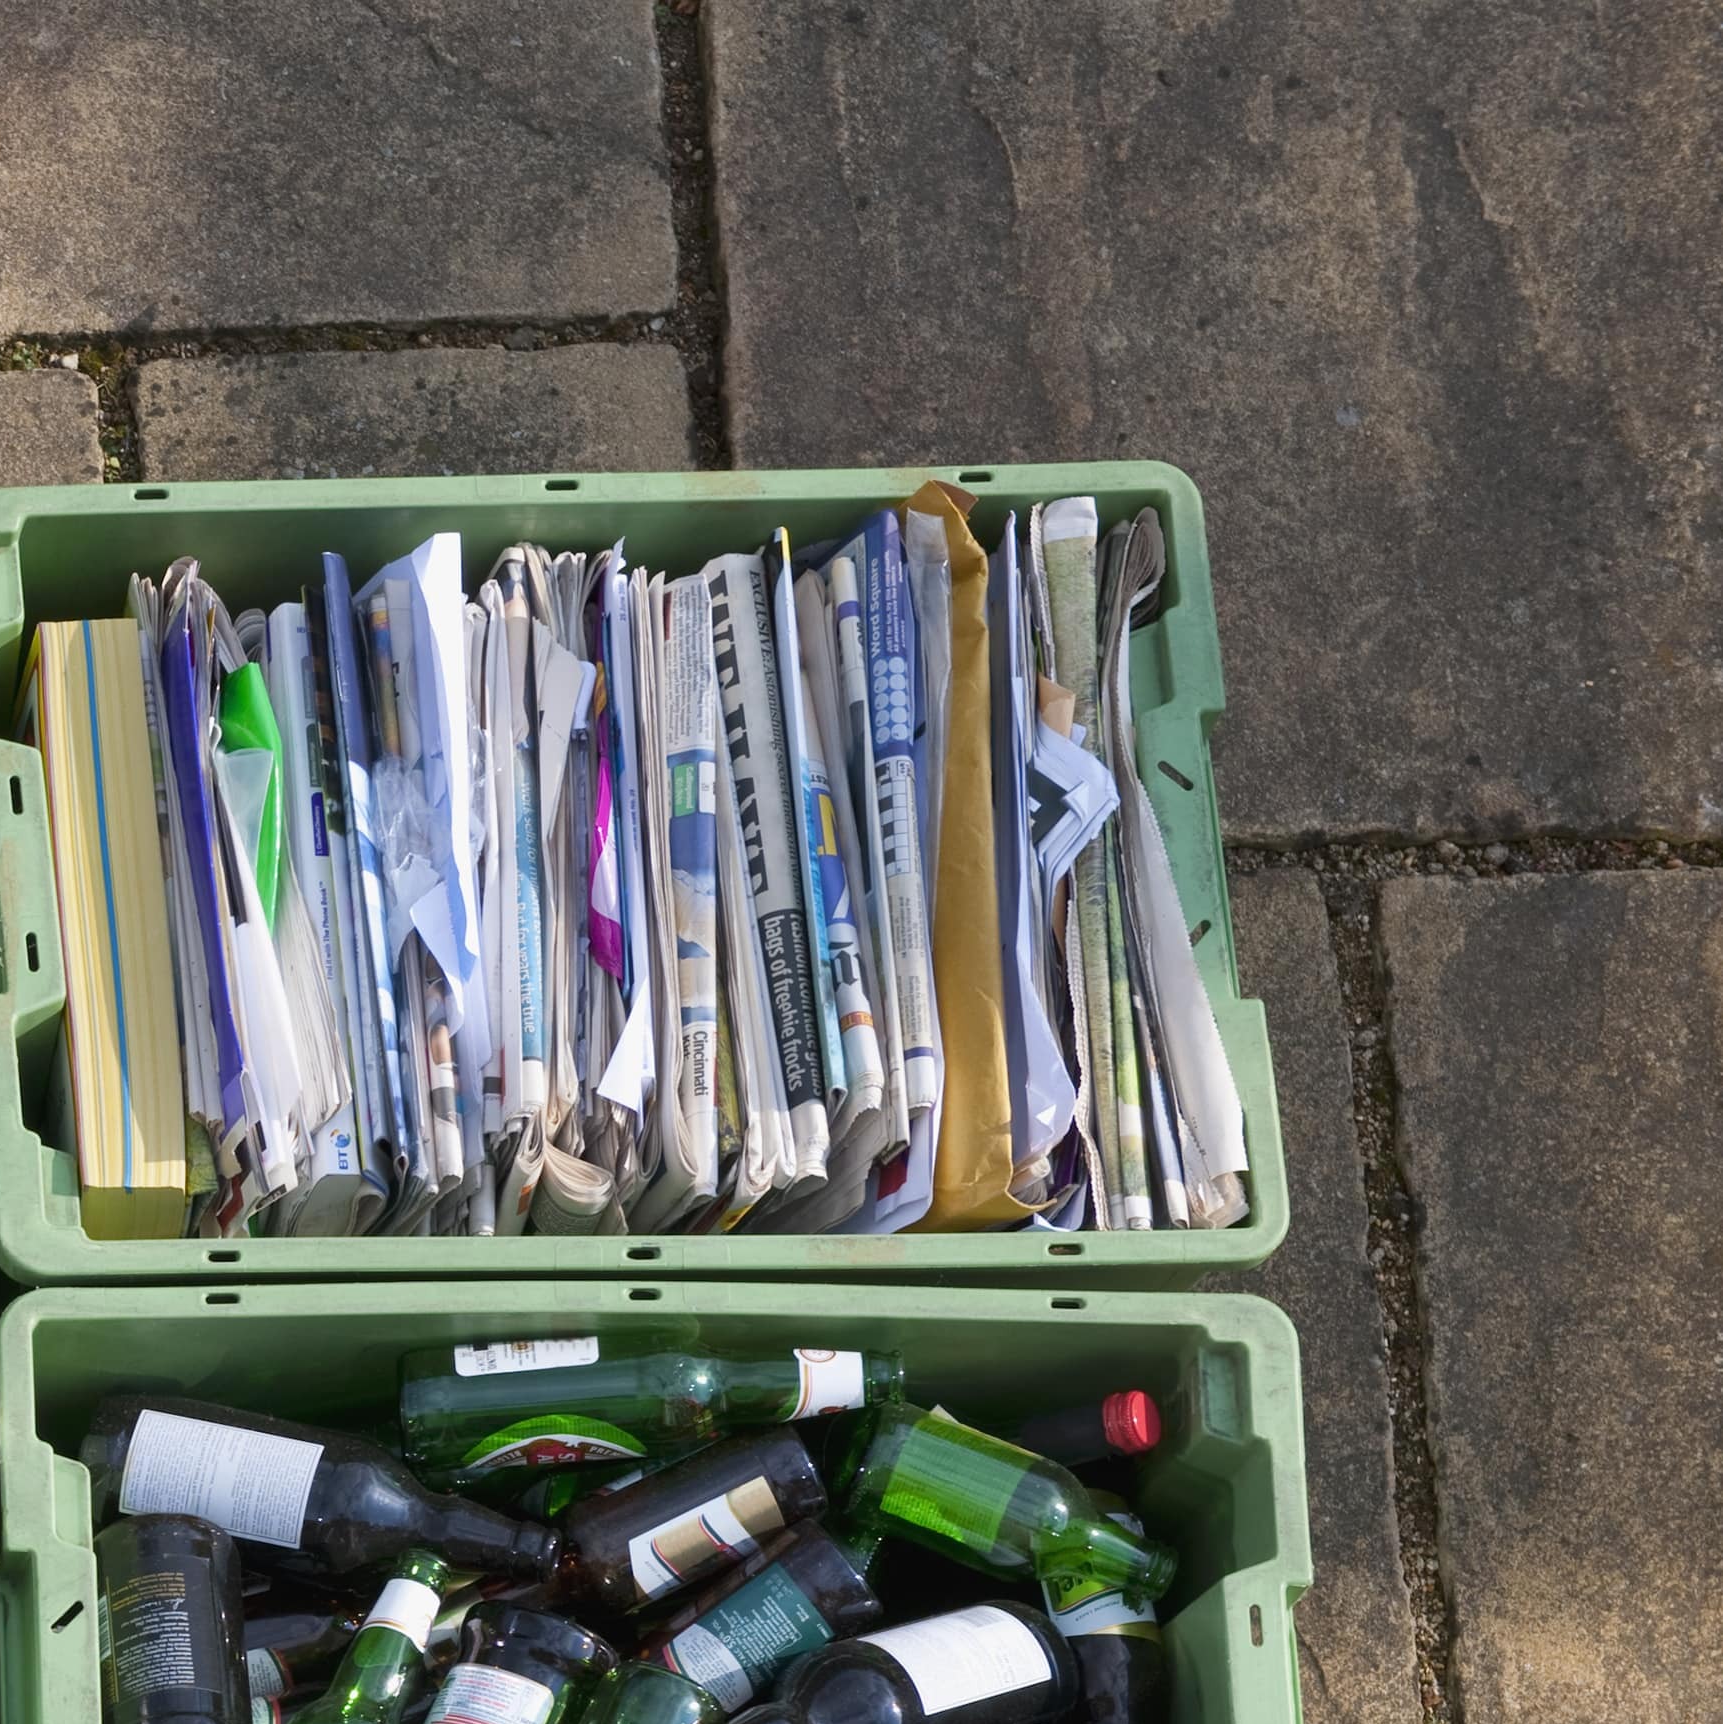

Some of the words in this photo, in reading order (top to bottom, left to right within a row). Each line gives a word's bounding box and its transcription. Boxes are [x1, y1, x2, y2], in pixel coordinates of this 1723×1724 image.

[870, 558, 883, 612] Square
[869, 614, 881, 659] Word
[749, 570, 773, 662] EXCLUSIVE:
[762, 664, 784, 751] Astonishing
[775, 752, 790, 795] secret
[524, 817, 537, 845] sells
[322, 930, 330, 942] The
[518, 927, 530, 949] for
[761, 915, 787, 958] bags
[773, 959, 794, 977] of
[521, 982, 536, 1004] the
[522, 1006, 536, 1033] true
[693, 1031, 709, 1097] Cincinnati
[782, 1040, 807, 1092] frocks
[336, 1150, 349, 1170] BT
